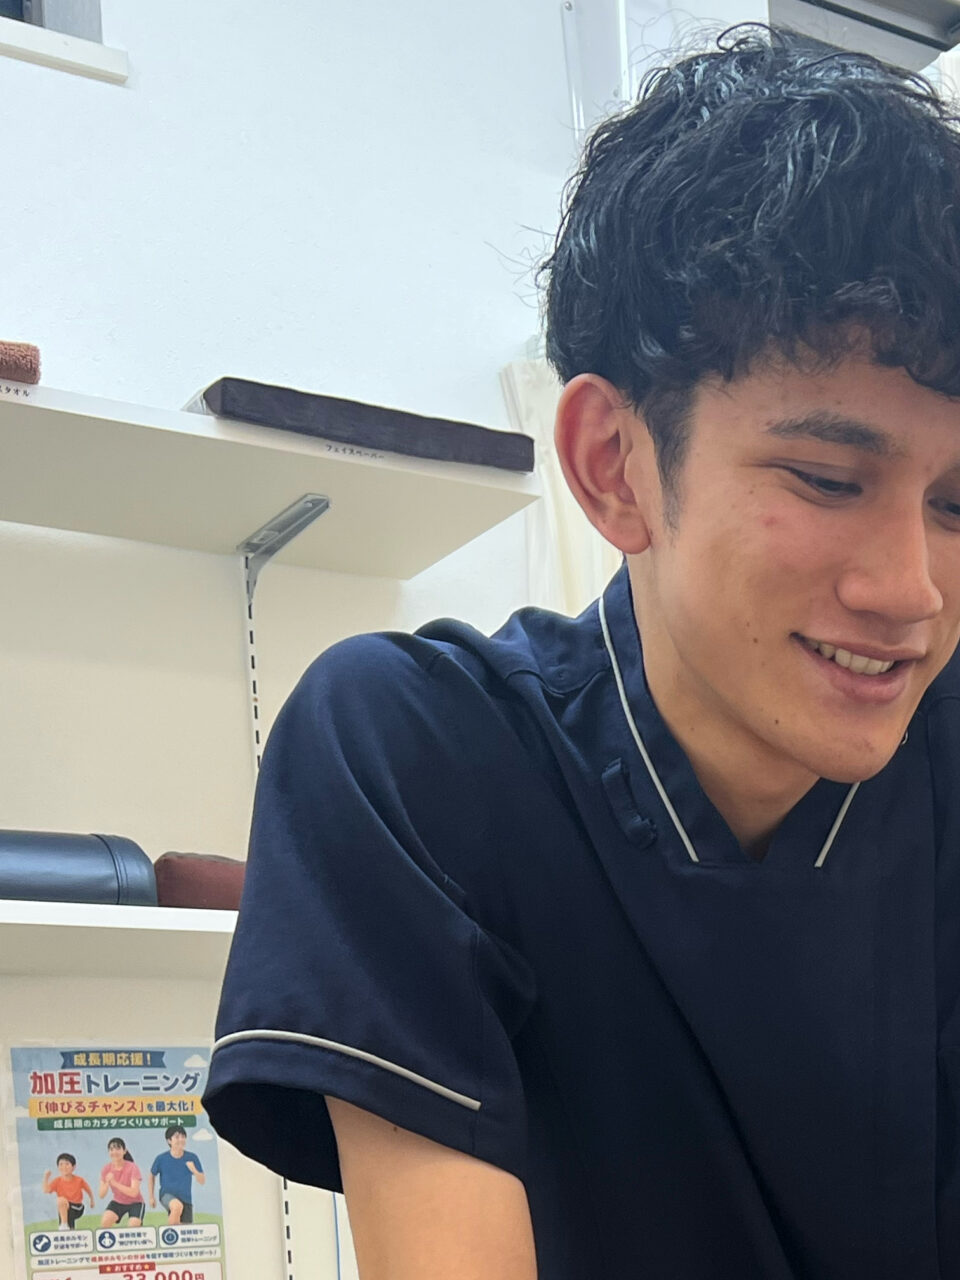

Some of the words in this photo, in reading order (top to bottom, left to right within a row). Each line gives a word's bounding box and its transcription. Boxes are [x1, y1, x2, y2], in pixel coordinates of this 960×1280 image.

[73, 1052, 152, 1066] 成長期応援！
[30, 1071, 201, 1095] 加圧トレーニング
[38, 1100, 195, 1114] 「伸びるチャンス」を最大化！
[53, 1117, 185, 1129] 成長期のカラダづくりをサポート
[114, 1264, 141, 1272] おすすめ
